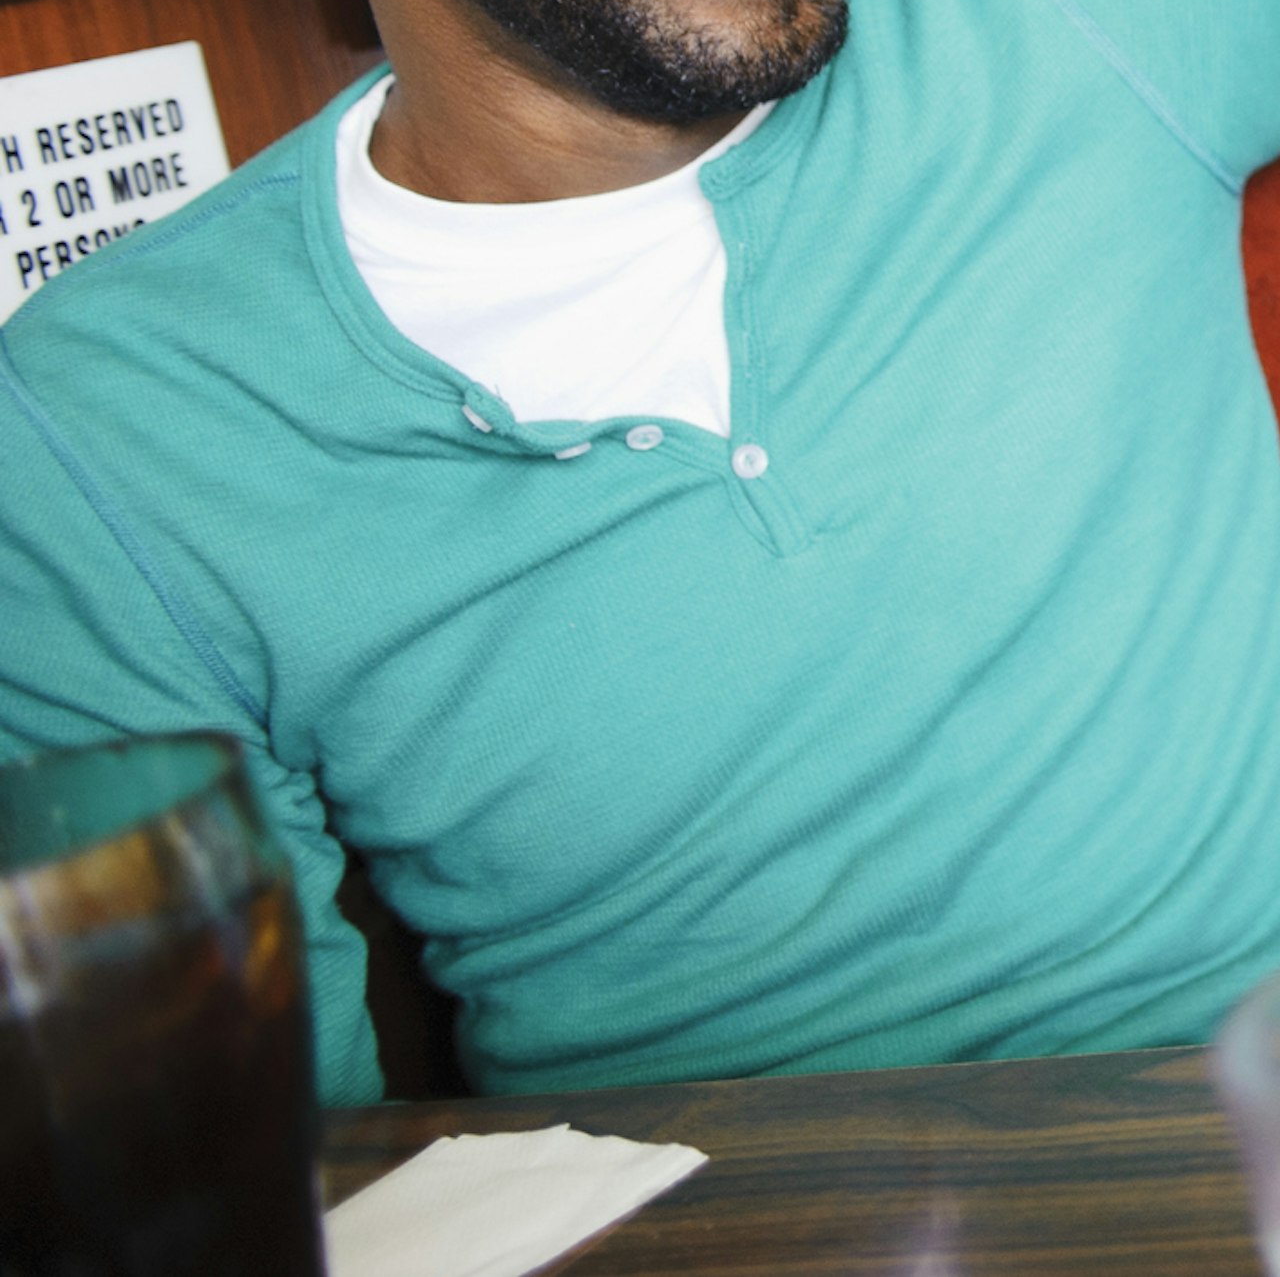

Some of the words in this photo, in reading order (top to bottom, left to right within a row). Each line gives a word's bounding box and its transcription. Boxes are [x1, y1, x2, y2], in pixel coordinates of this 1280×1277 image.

[36, 99, 184, 164] RESERVED
[21, 189, 42, 227] 2
[54, 176, 96, 219] OR
[107, 152, 188, 205] MORE
[16, 218, 146, 289] PERS
